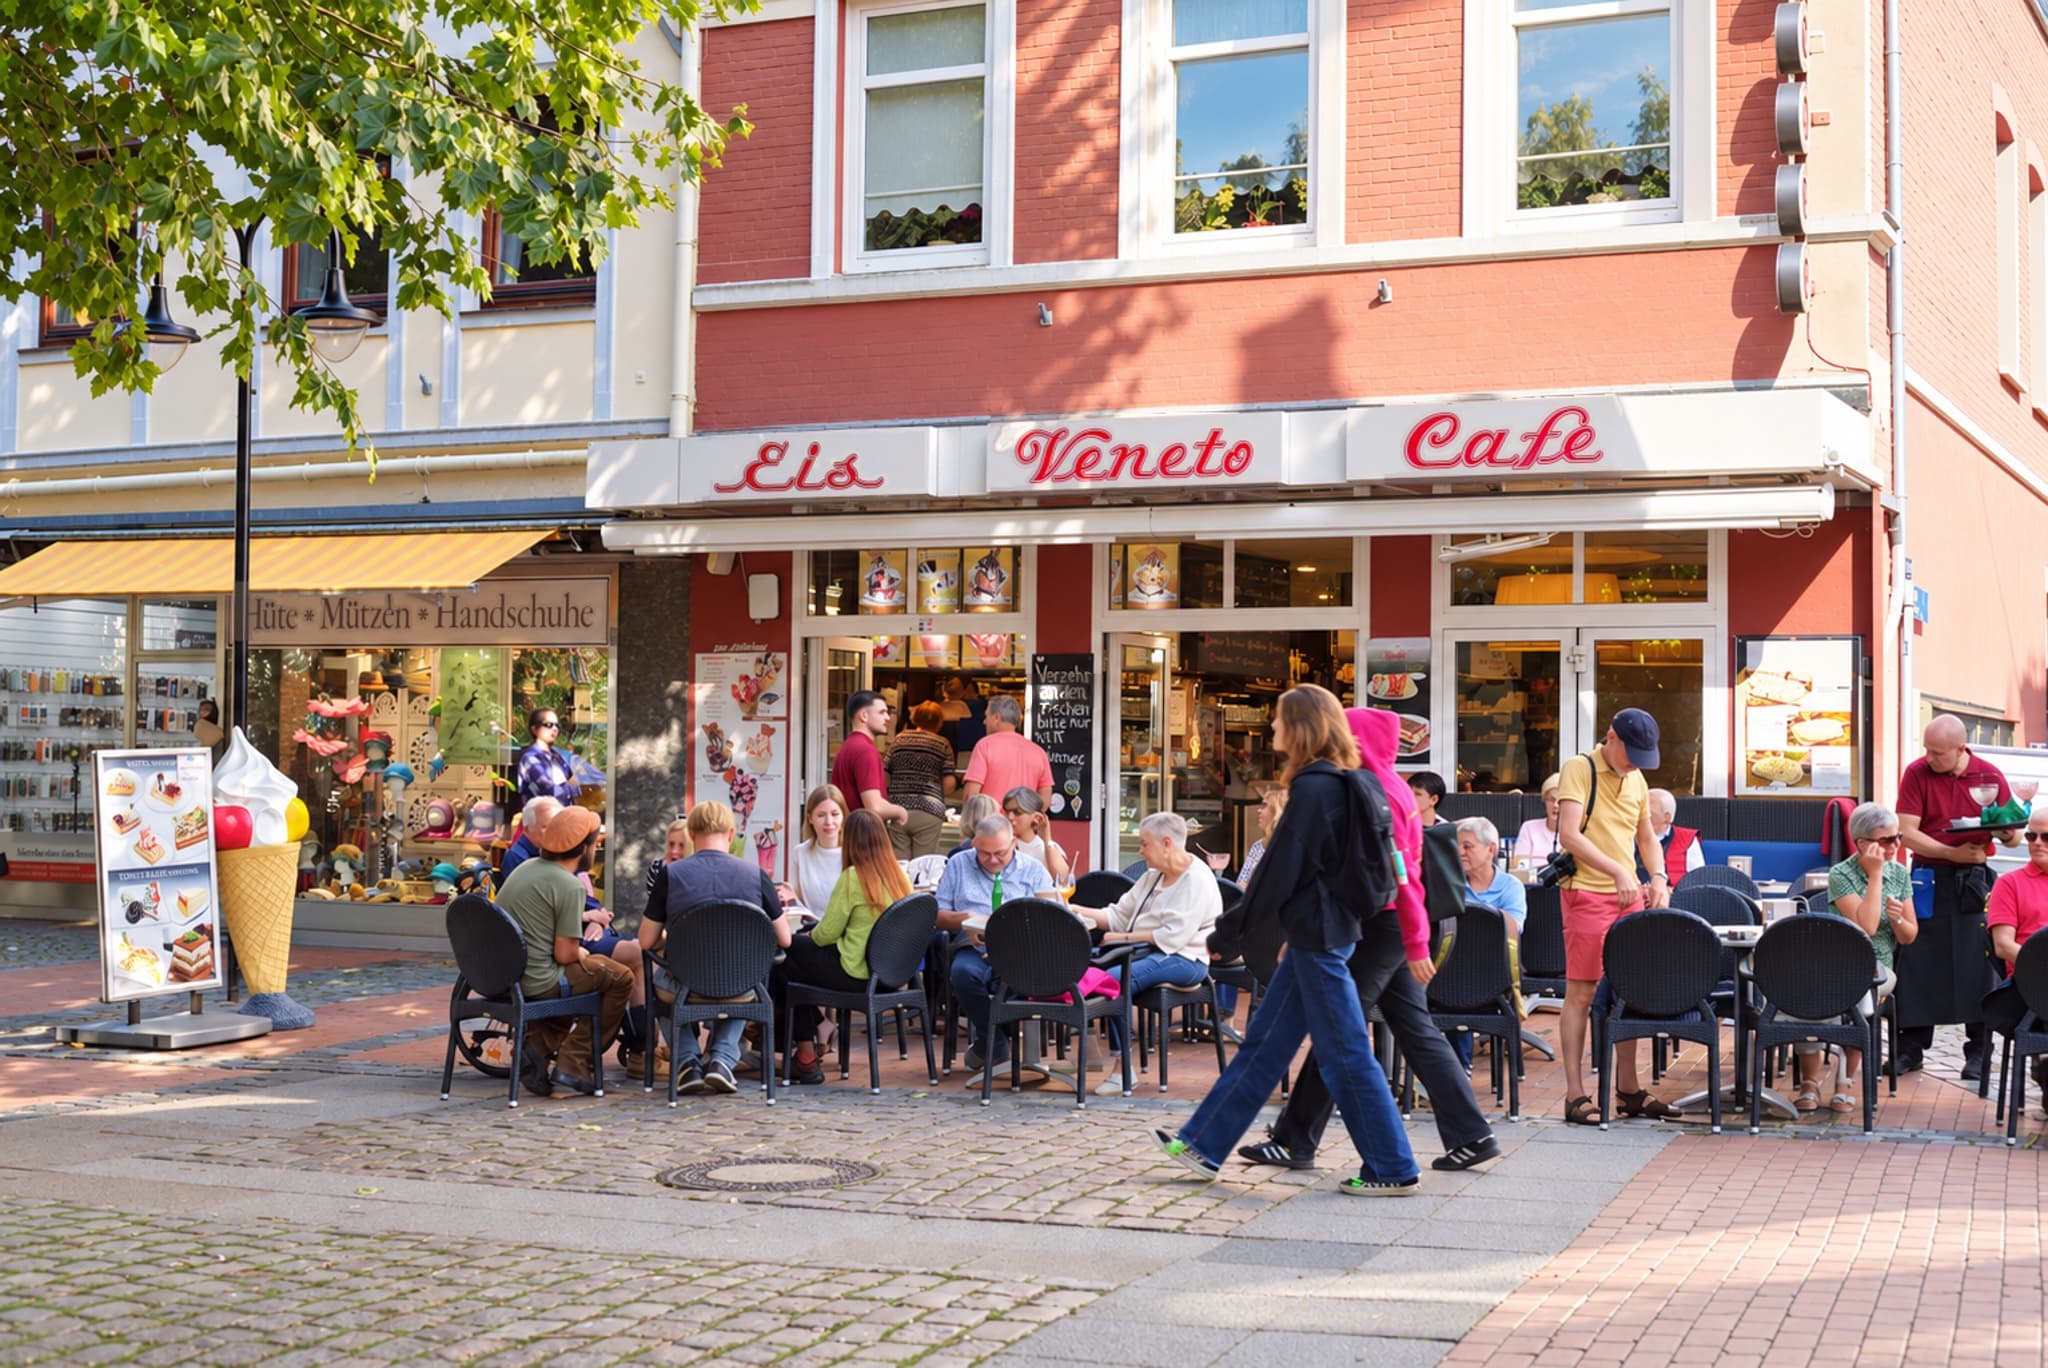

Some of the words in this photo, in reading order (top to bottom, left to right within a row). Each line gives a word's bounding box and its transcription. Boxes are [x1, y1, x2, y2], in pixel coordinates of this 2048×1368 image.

[714, 440, 883, 493] Eis
[1014, 427, 1253, 484] Veneto
[1404, 405, 1603, 470] Cafe
[249, 595, 298, 630] Hüte
[320, 593, 411, 630] Mützen
[434, 592, 594, 630] Handschuhe
[1035, 664, 1091, 684] Verzehr
[1039, 685, 1058, 700] an
[1060, 684, 1087, 700] den
[1037, 715, 1067, 729] bitte
[1070, 717, 1091, 729] nur
